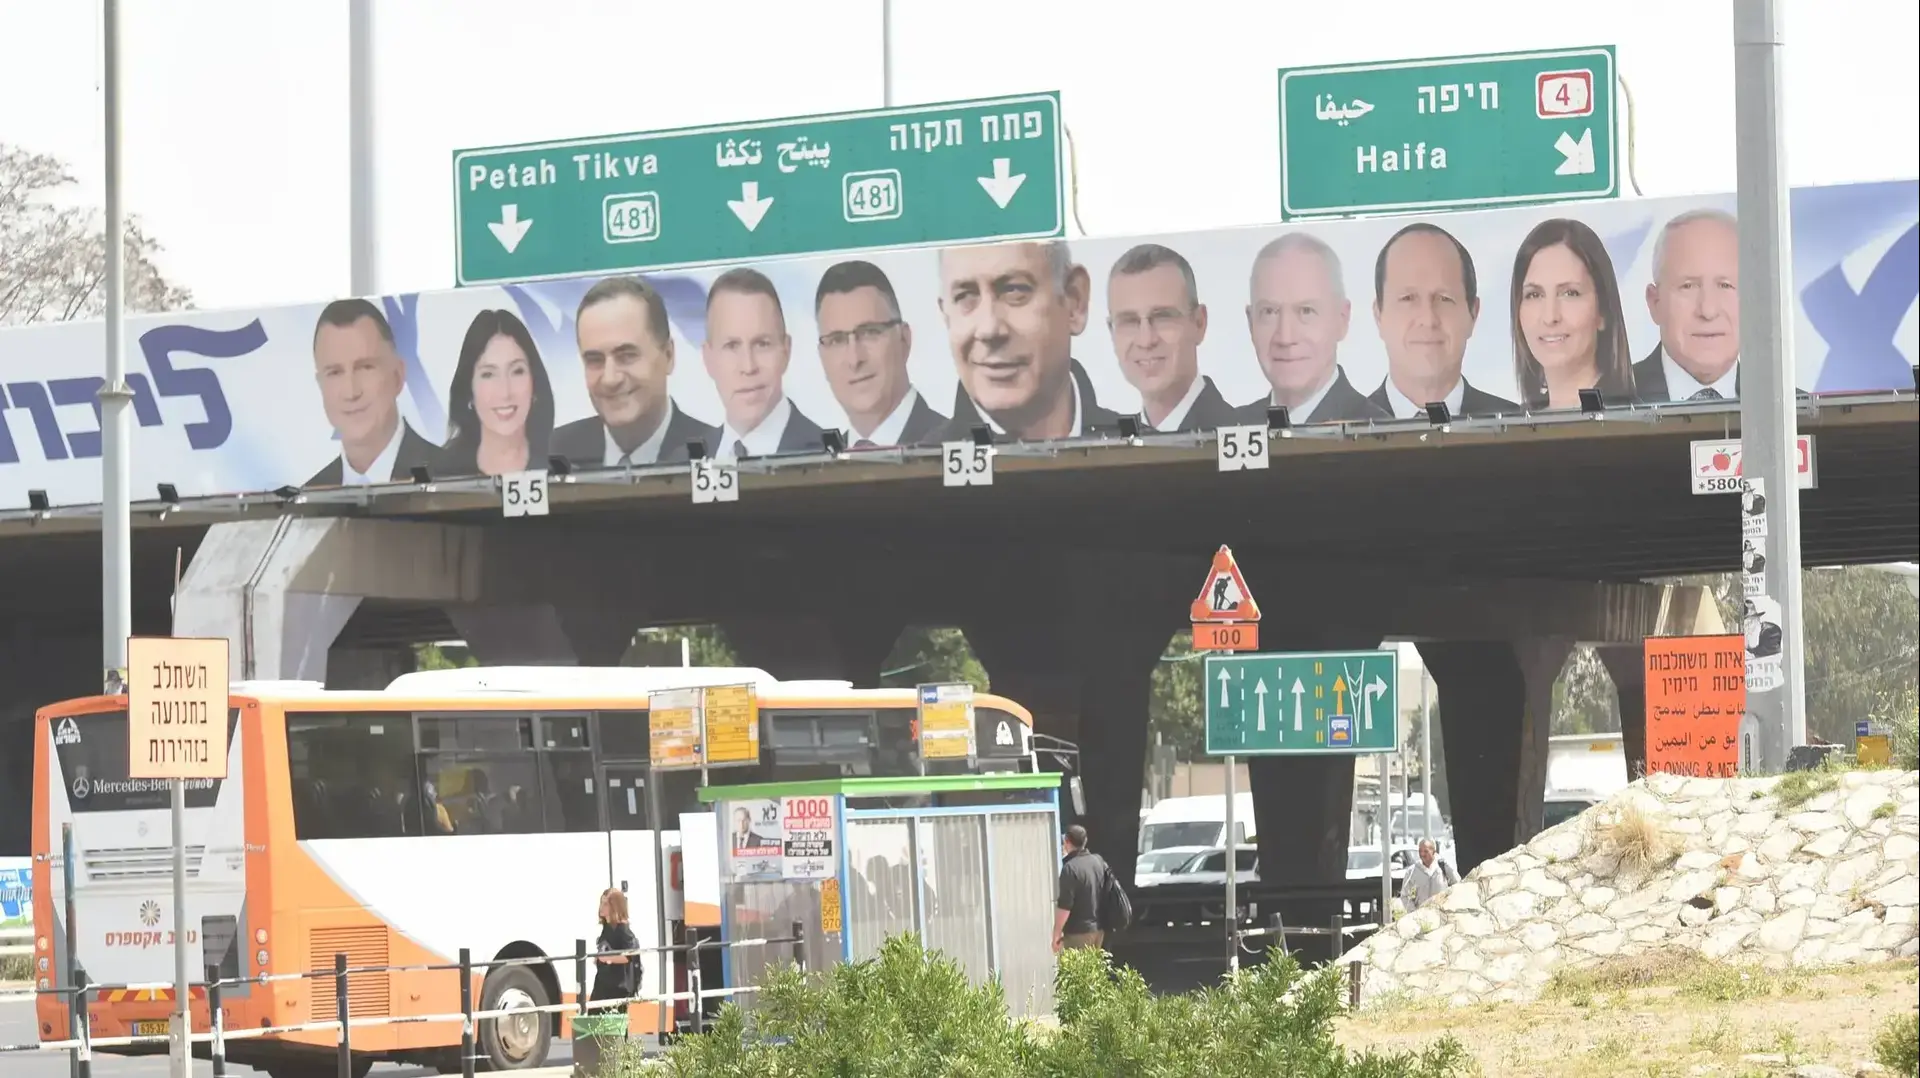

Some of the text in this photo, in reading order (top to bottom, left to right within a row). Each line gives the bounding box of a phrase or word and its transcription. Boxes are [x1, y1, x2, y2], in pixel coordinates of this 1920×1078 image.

[1418, 81, 1498, 113] חיפה
[1555, 83, 1571, 106] 4
[1316, 93, 1375, 126] حيفا
[890, 111, 1042, 152] פתח תקוה
[1357, 142, 1447, 173] Haifa
[469, 152, 658, 191] Petah Tikva
[852, 185, 893, 209] 481
[612, 207, 652, 230] 481
[0, 318, 268, 463] ליכו
[1222, 431, 1263, 459] 5.5
[948, 448, 987, 474] 5.5
[696, 465, 732, 491] 5.5
[508, 479, 543, 504] 5.5
[1212, 629, 1241, 645] 100
[1650, 651, 1708, 671] משתלבות
[153, 660, 207, 689] השתלב
[1662, 676, 1698, 696] מימין
[152, 701, 207, 724] בתנועה
[149, 739, 208, 763] בזהירות
[93, 778, 173, 794] Mercedes-Ben
[762, 804, 777, 820] לא
[786, 799, 829, 818] 1000
[105, 931, 161, 949] אקספרס
